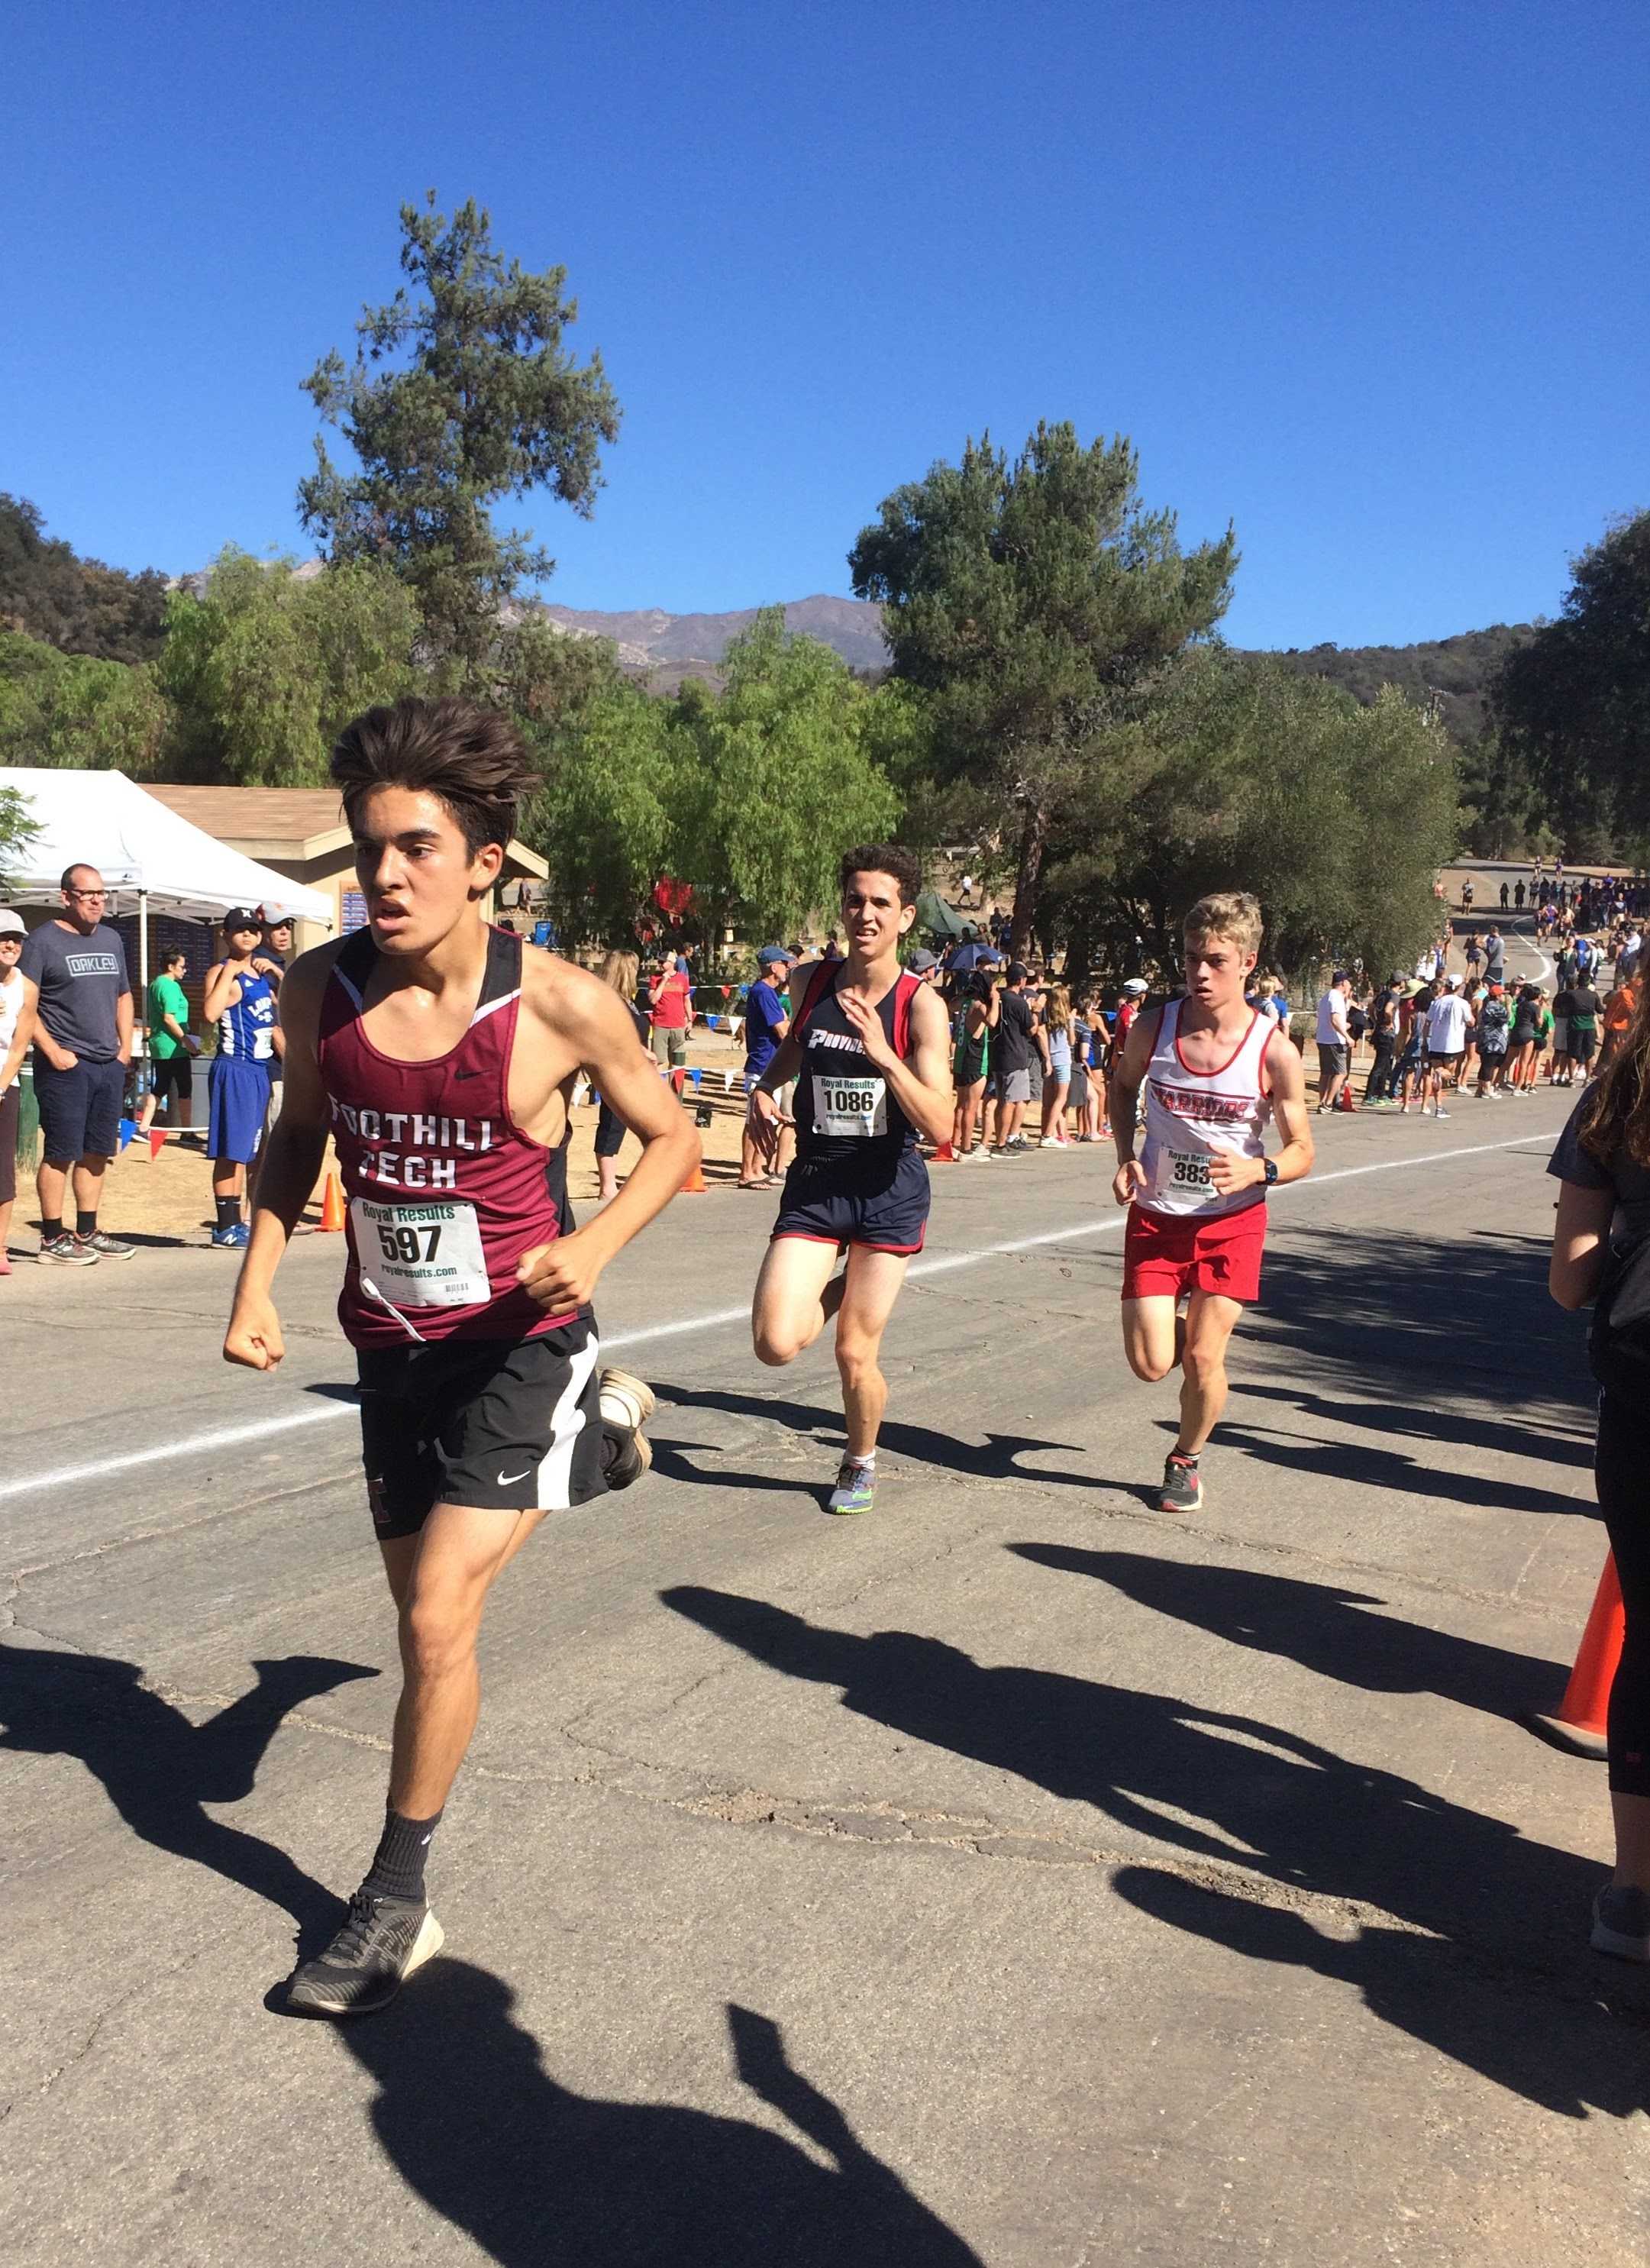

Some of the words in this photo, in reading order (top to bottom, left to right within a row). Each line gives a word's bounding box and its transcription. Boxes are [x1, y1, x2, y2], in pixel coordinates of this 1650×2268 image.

[71, 957, 115, 971] OAKLEY
[807, 1029, 866, 1055] PROVIDE
[822, 1078, 842, 1089] Royal
[844, 1080, 876, 1089] Results
[824, 1090, 873, 1112] 1086
[327, 1092, 496, 1152] FOOTHILL
[1168, 1150, 1189, 1161] Royal
[358, 1149, 457, 1189] TECH
[1174, 1162, 1210, 1184] 383
[363, 1201, 394, 1222] Royal
[396, 1206, 456, 1223] Results
[376, 1224, 441, 1263] 597
